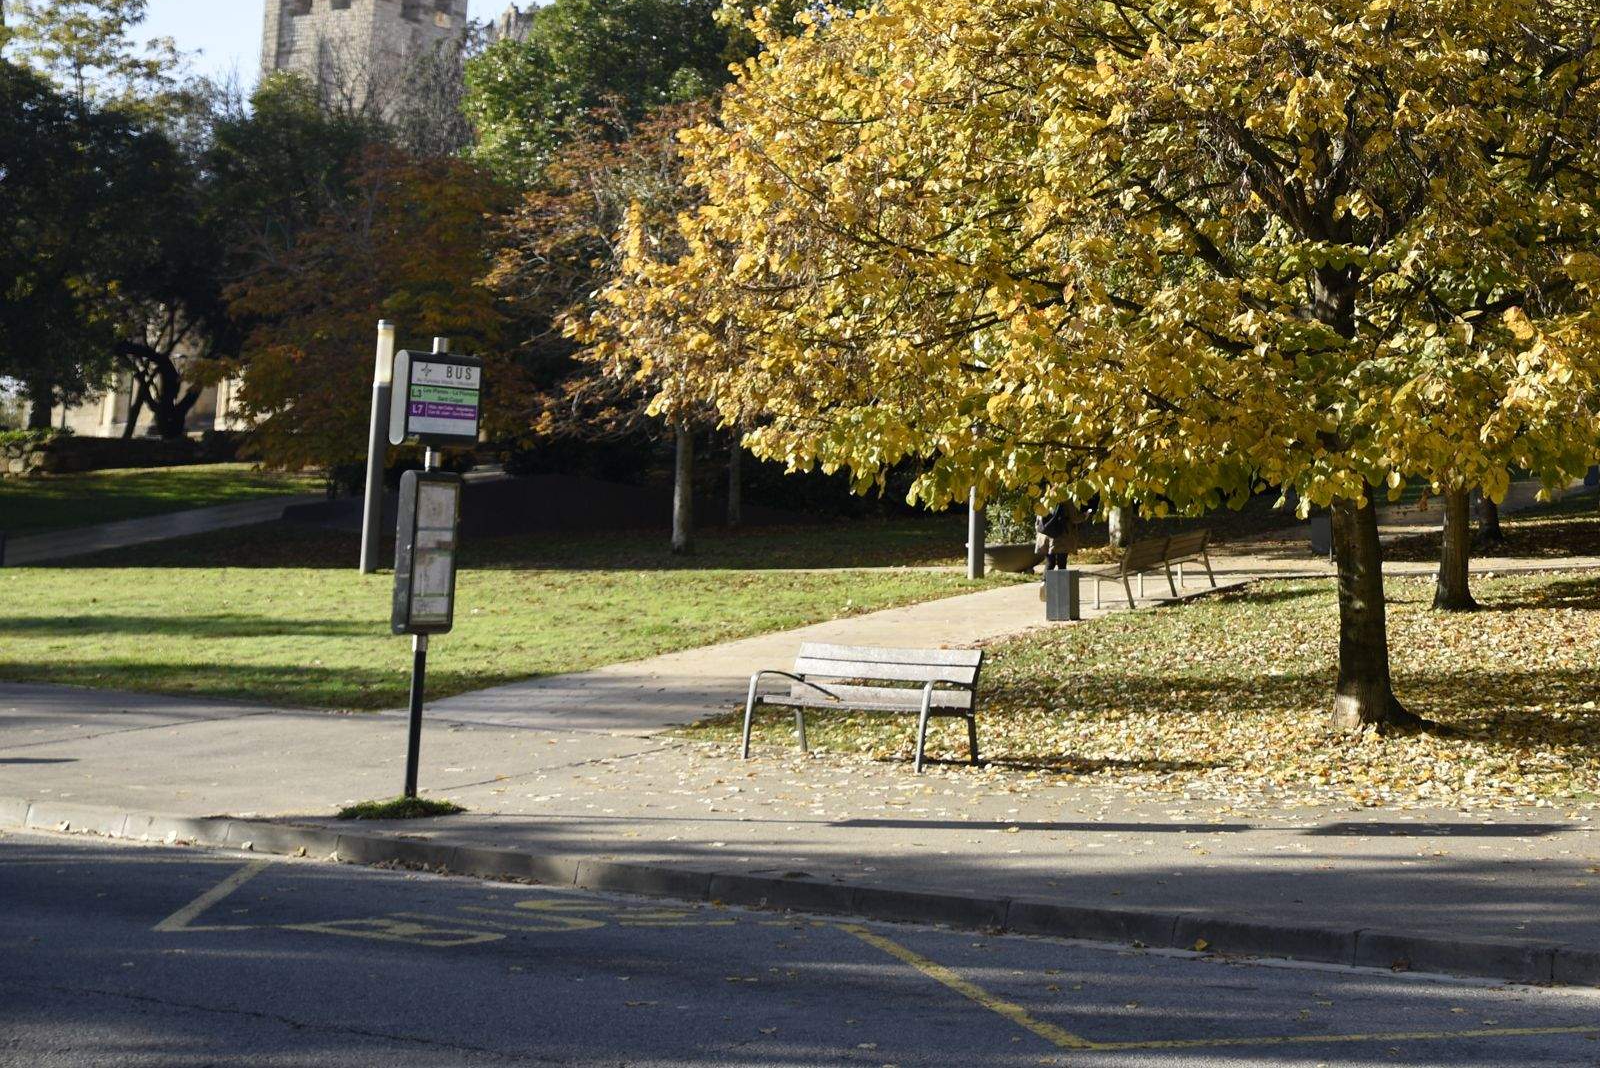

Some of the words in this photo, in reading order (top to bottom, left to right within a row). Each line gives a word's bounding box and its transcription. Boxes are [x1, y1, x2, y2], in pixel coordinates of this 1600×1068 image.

[446, 366, 472, 380] BUS
[412, 404, 423, 414] L7
[283, 899, 702, 947] BUS
